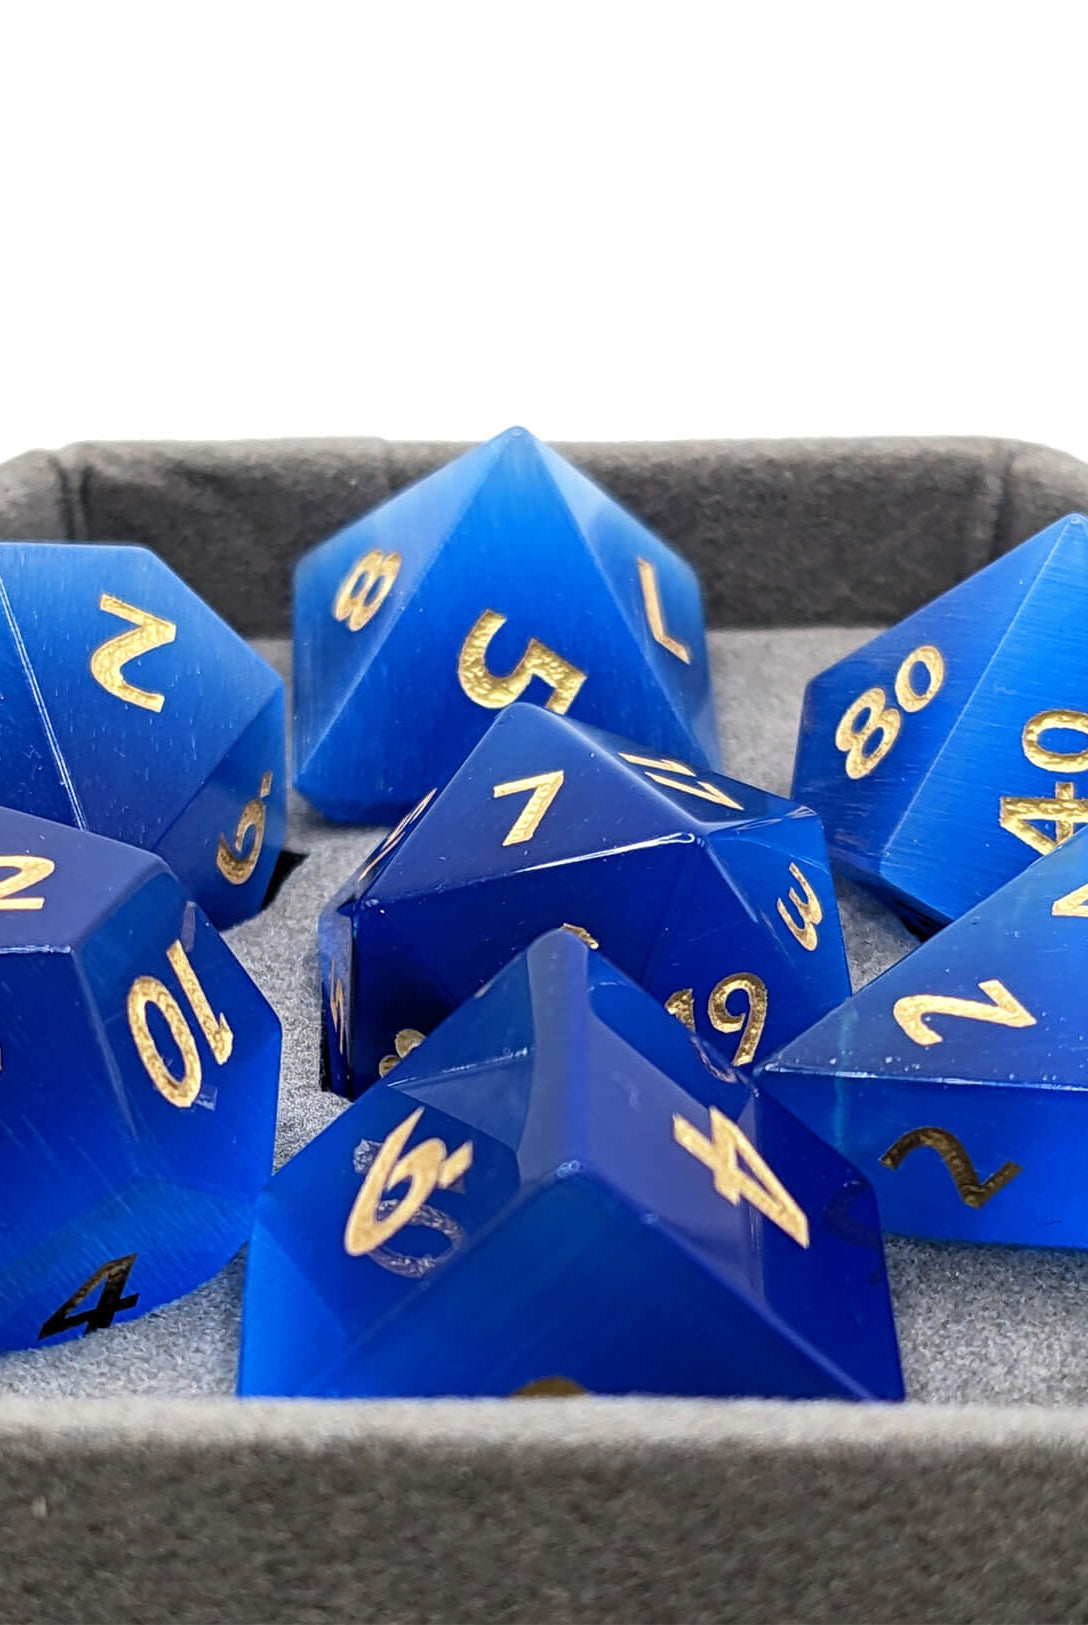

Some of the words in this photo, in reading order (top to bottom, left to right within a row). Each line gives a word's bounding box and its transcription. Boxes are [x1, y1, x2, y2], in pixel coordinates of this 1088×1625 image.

[334, 549, 401, 632] 8
[90, 592, 176, 713] 2
[458, 608, 587, 714] 5
[835, 645, 945, 780] 80
[493, 770, 564, 846] 7
[999, 709, 1088, 857] 40
[777, 862, 823, 951] 3
[127, 939, 234, 1107] 10
[893, 979, 1037, 1046] 2
[672, 1106, 810, 1249] 4
[877, 1126, 1023, 1209] 2
[37, 1252, 140, 1340] 4
